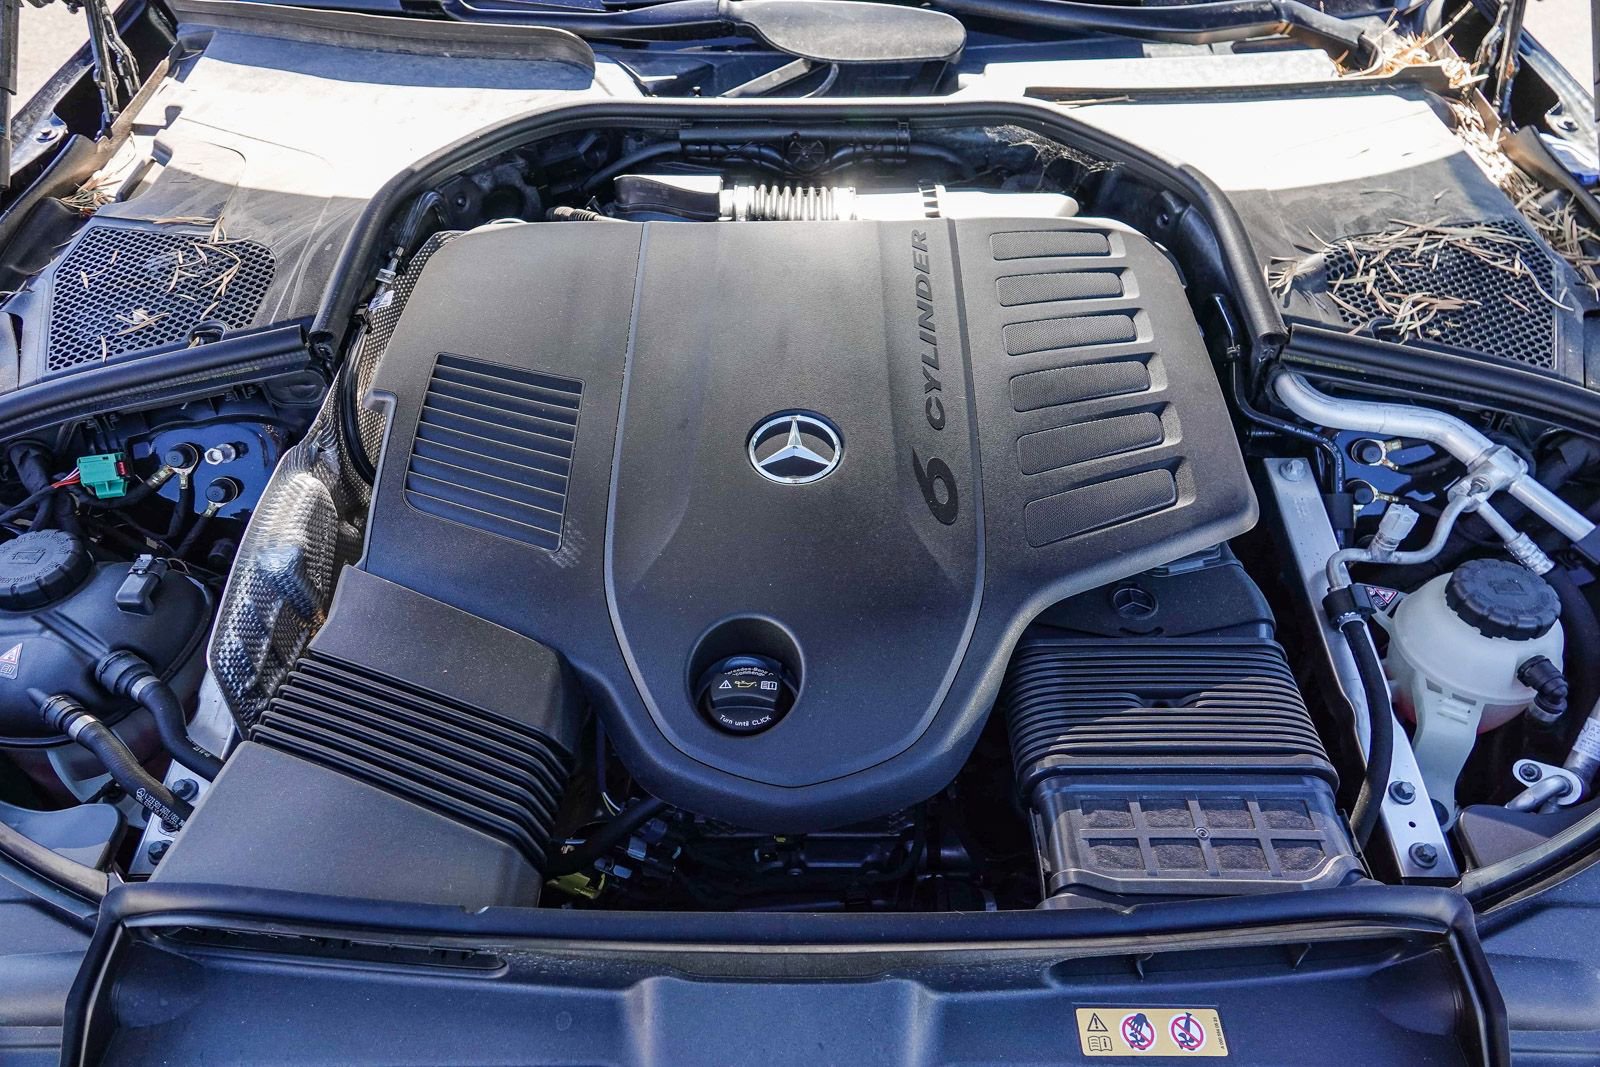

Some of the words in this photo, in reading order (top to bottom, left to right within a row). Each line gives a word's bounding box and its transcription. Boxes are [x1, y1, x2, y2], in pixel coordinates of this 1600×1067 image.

[911, 228, 946, 431] CYLINDER
[912, 445, 959, 526] 6
[720, 714, 733, 724] Turn
[752, 715, 771, 726] CLICK
